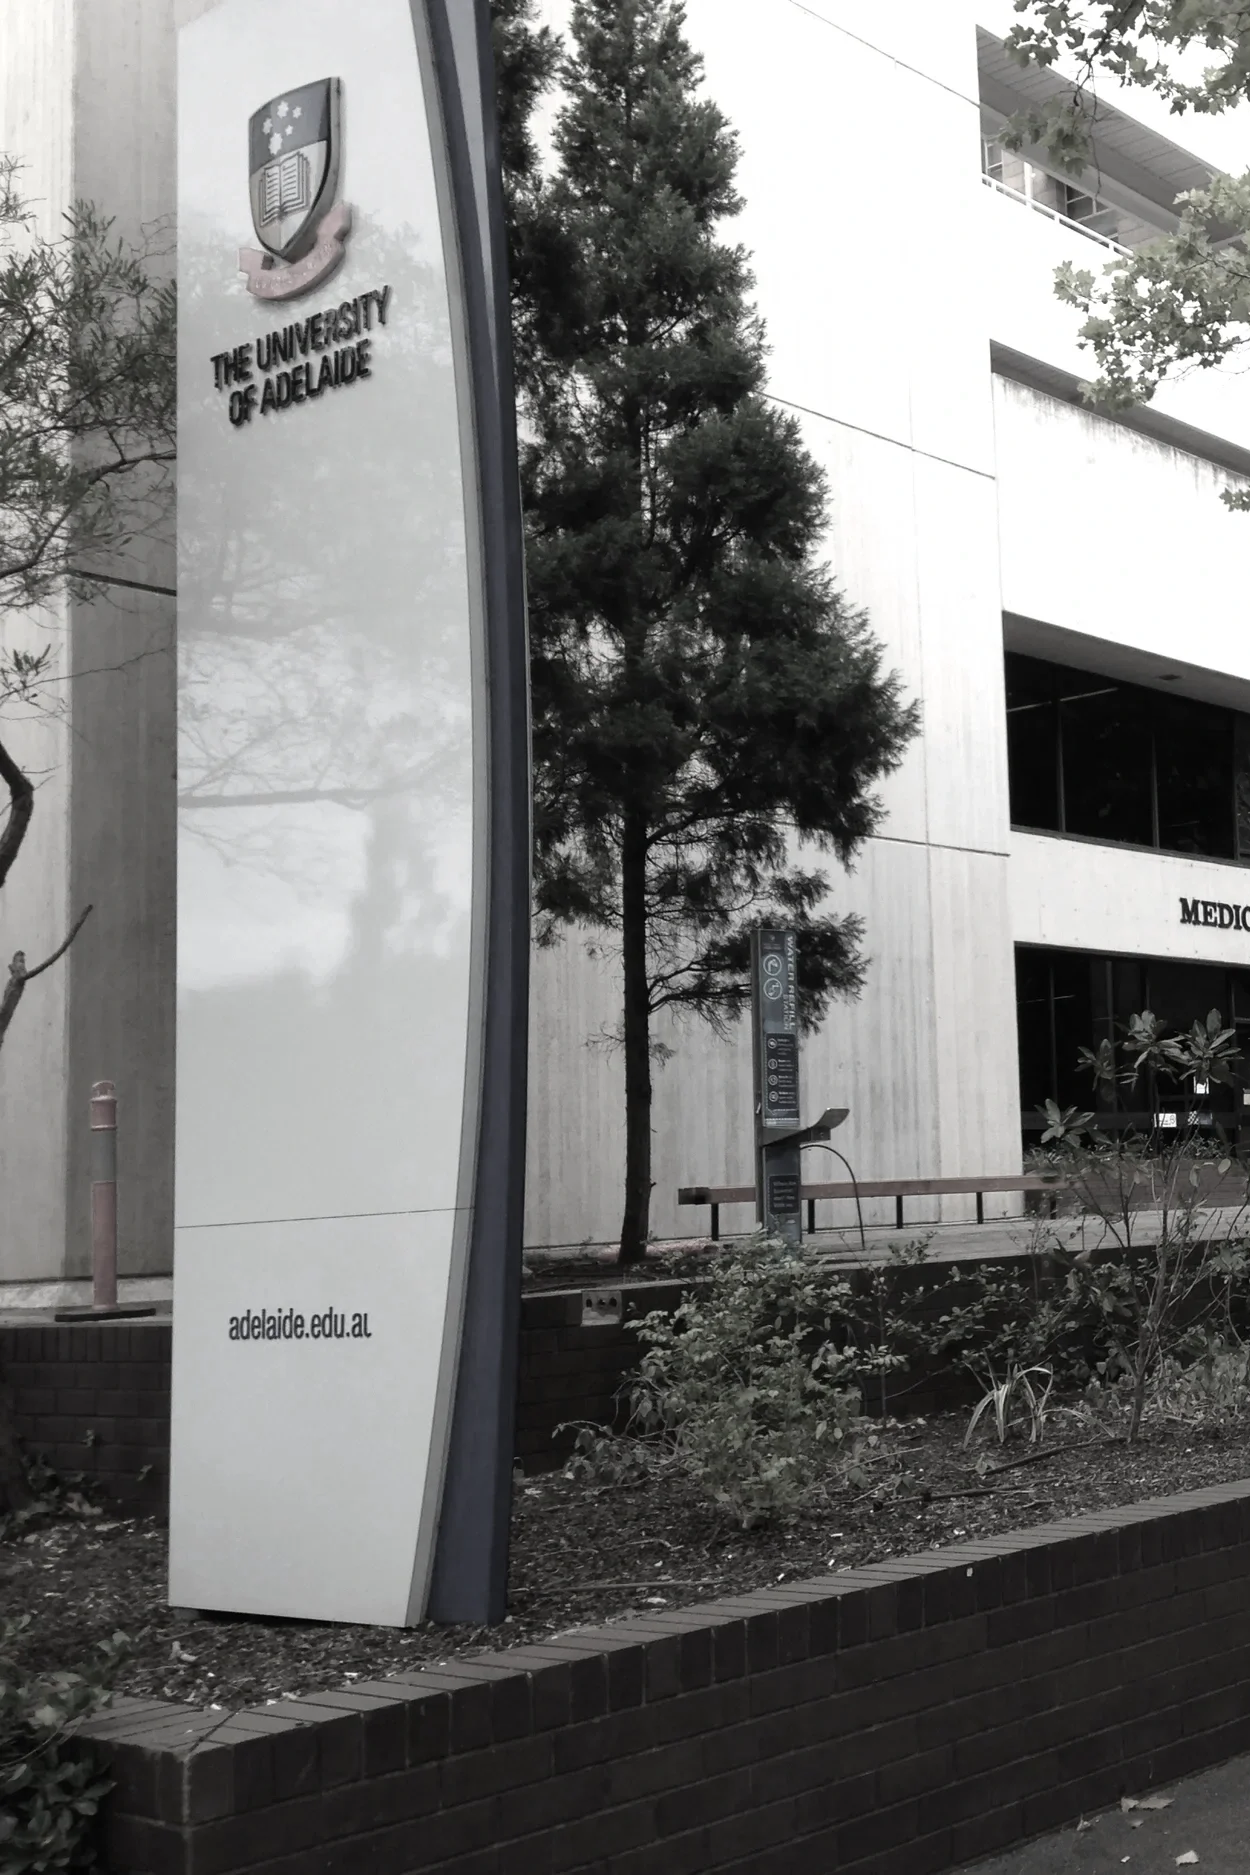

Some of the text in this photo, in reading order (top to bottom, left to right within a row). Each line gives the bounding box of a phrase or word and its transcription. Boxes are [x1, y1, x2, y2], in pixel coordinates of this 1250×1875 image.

[210, 285, 391, 391] THE UNIVERSITY
[229, 338, 371, 427] OF ADELAIDE
[787, 935, 795, 981] WATER
